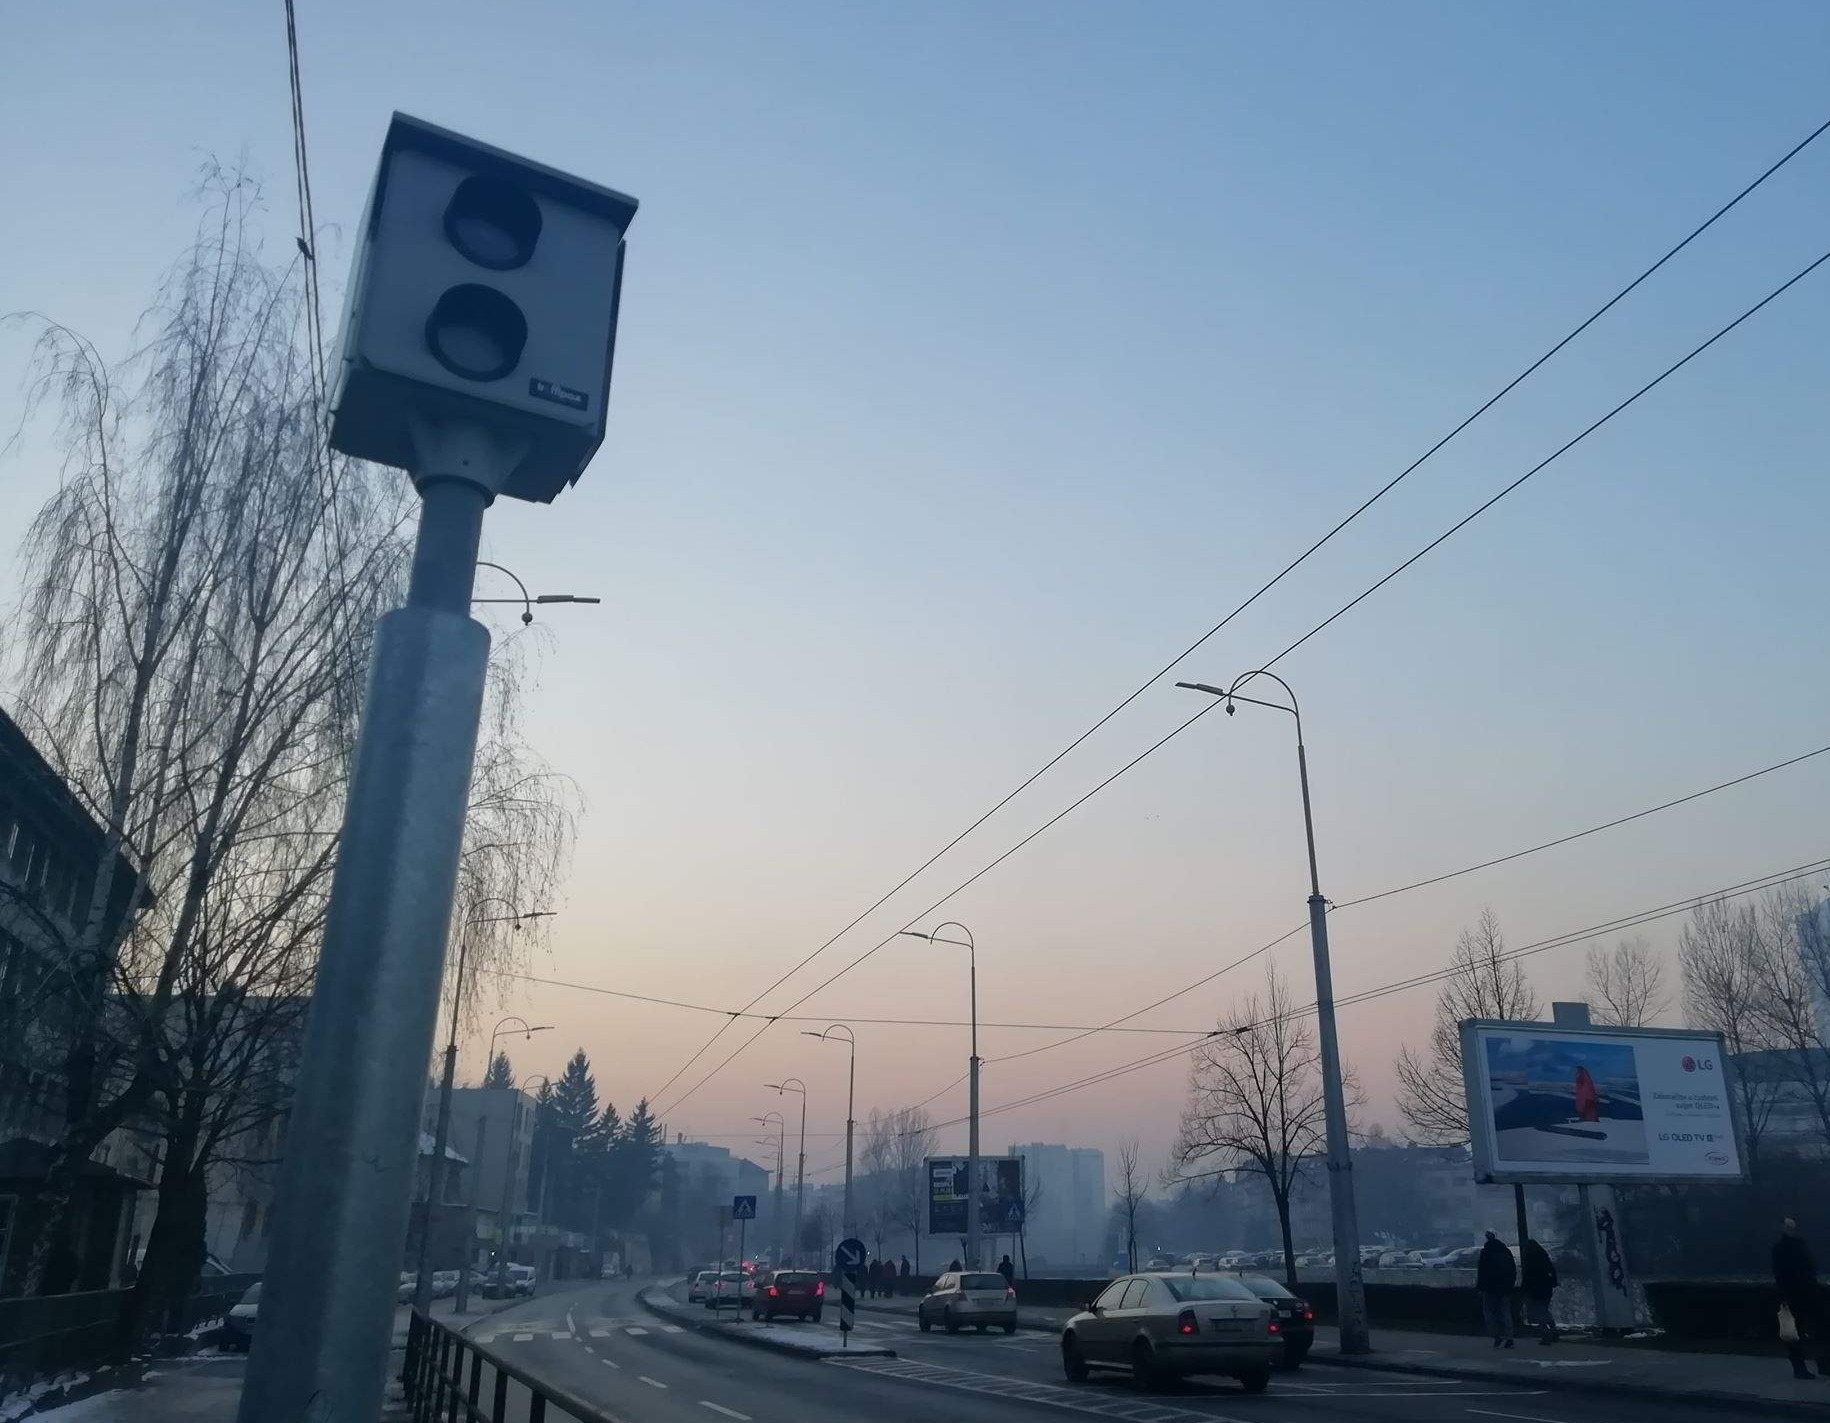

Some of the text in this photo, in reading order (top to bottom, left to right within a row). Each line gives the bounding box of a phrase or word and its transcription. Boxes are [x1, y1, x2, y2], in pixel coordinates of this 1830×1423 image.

[1697, 1059, 1714, 1071] LG
[1658, 1132, 1670, 1141] LG
[1671, 1132, 1694, 1142] OLED
[1694, 1133, 1706, 1142] TV
